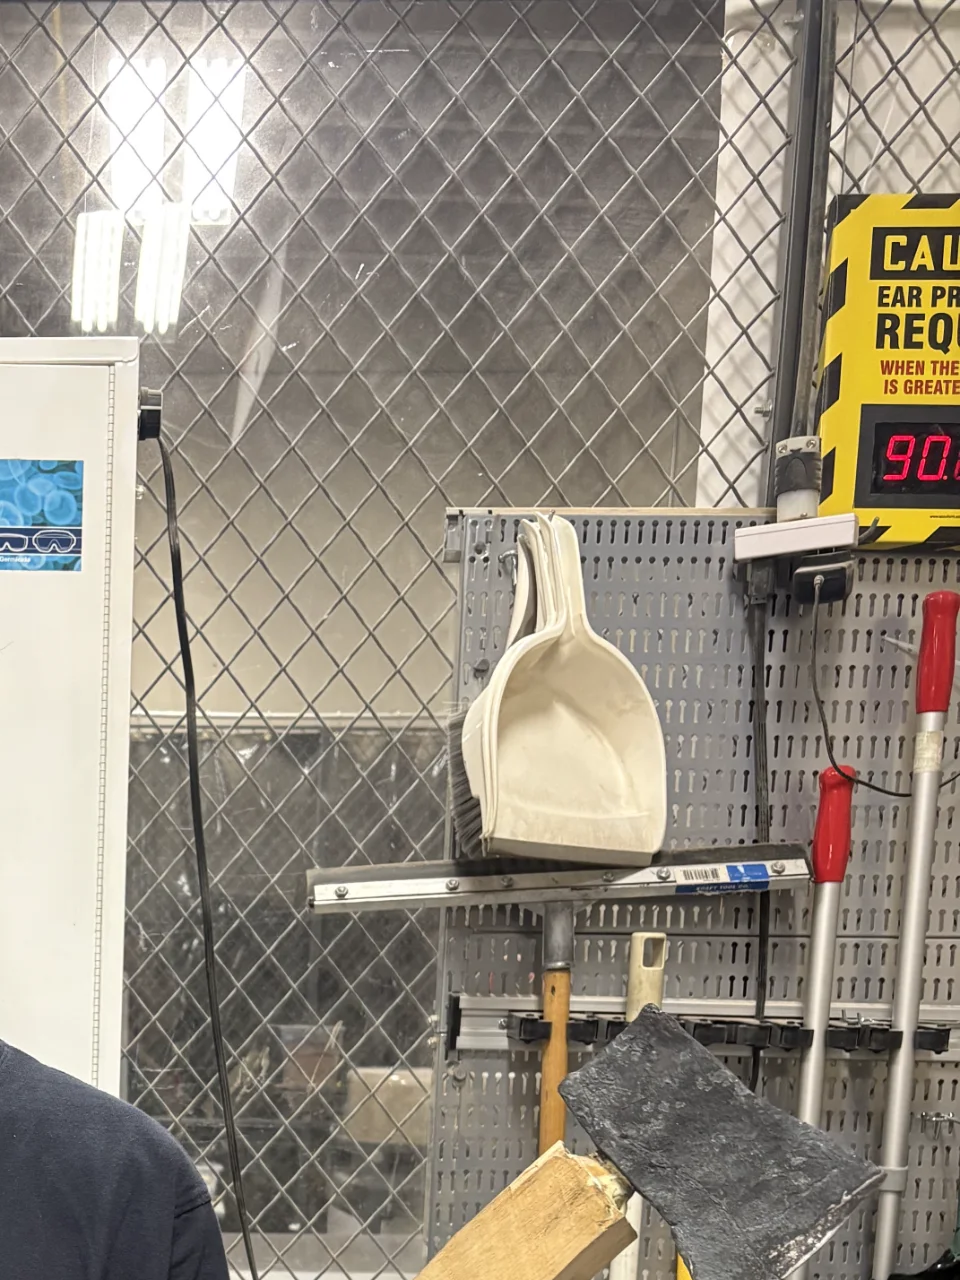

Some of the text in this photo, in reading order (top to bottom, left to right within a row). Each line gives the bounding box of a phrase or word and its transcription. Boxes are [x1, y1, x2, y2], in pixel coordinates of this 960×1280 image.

[877, 286, 960, 308] EAR PR
[875, 312, 960, 355] REQ
[880, 359, 960, 376] WHEN THE
[883, 379, 960, 395] IS GREATE
[883, 435, 960, 481] 90.
